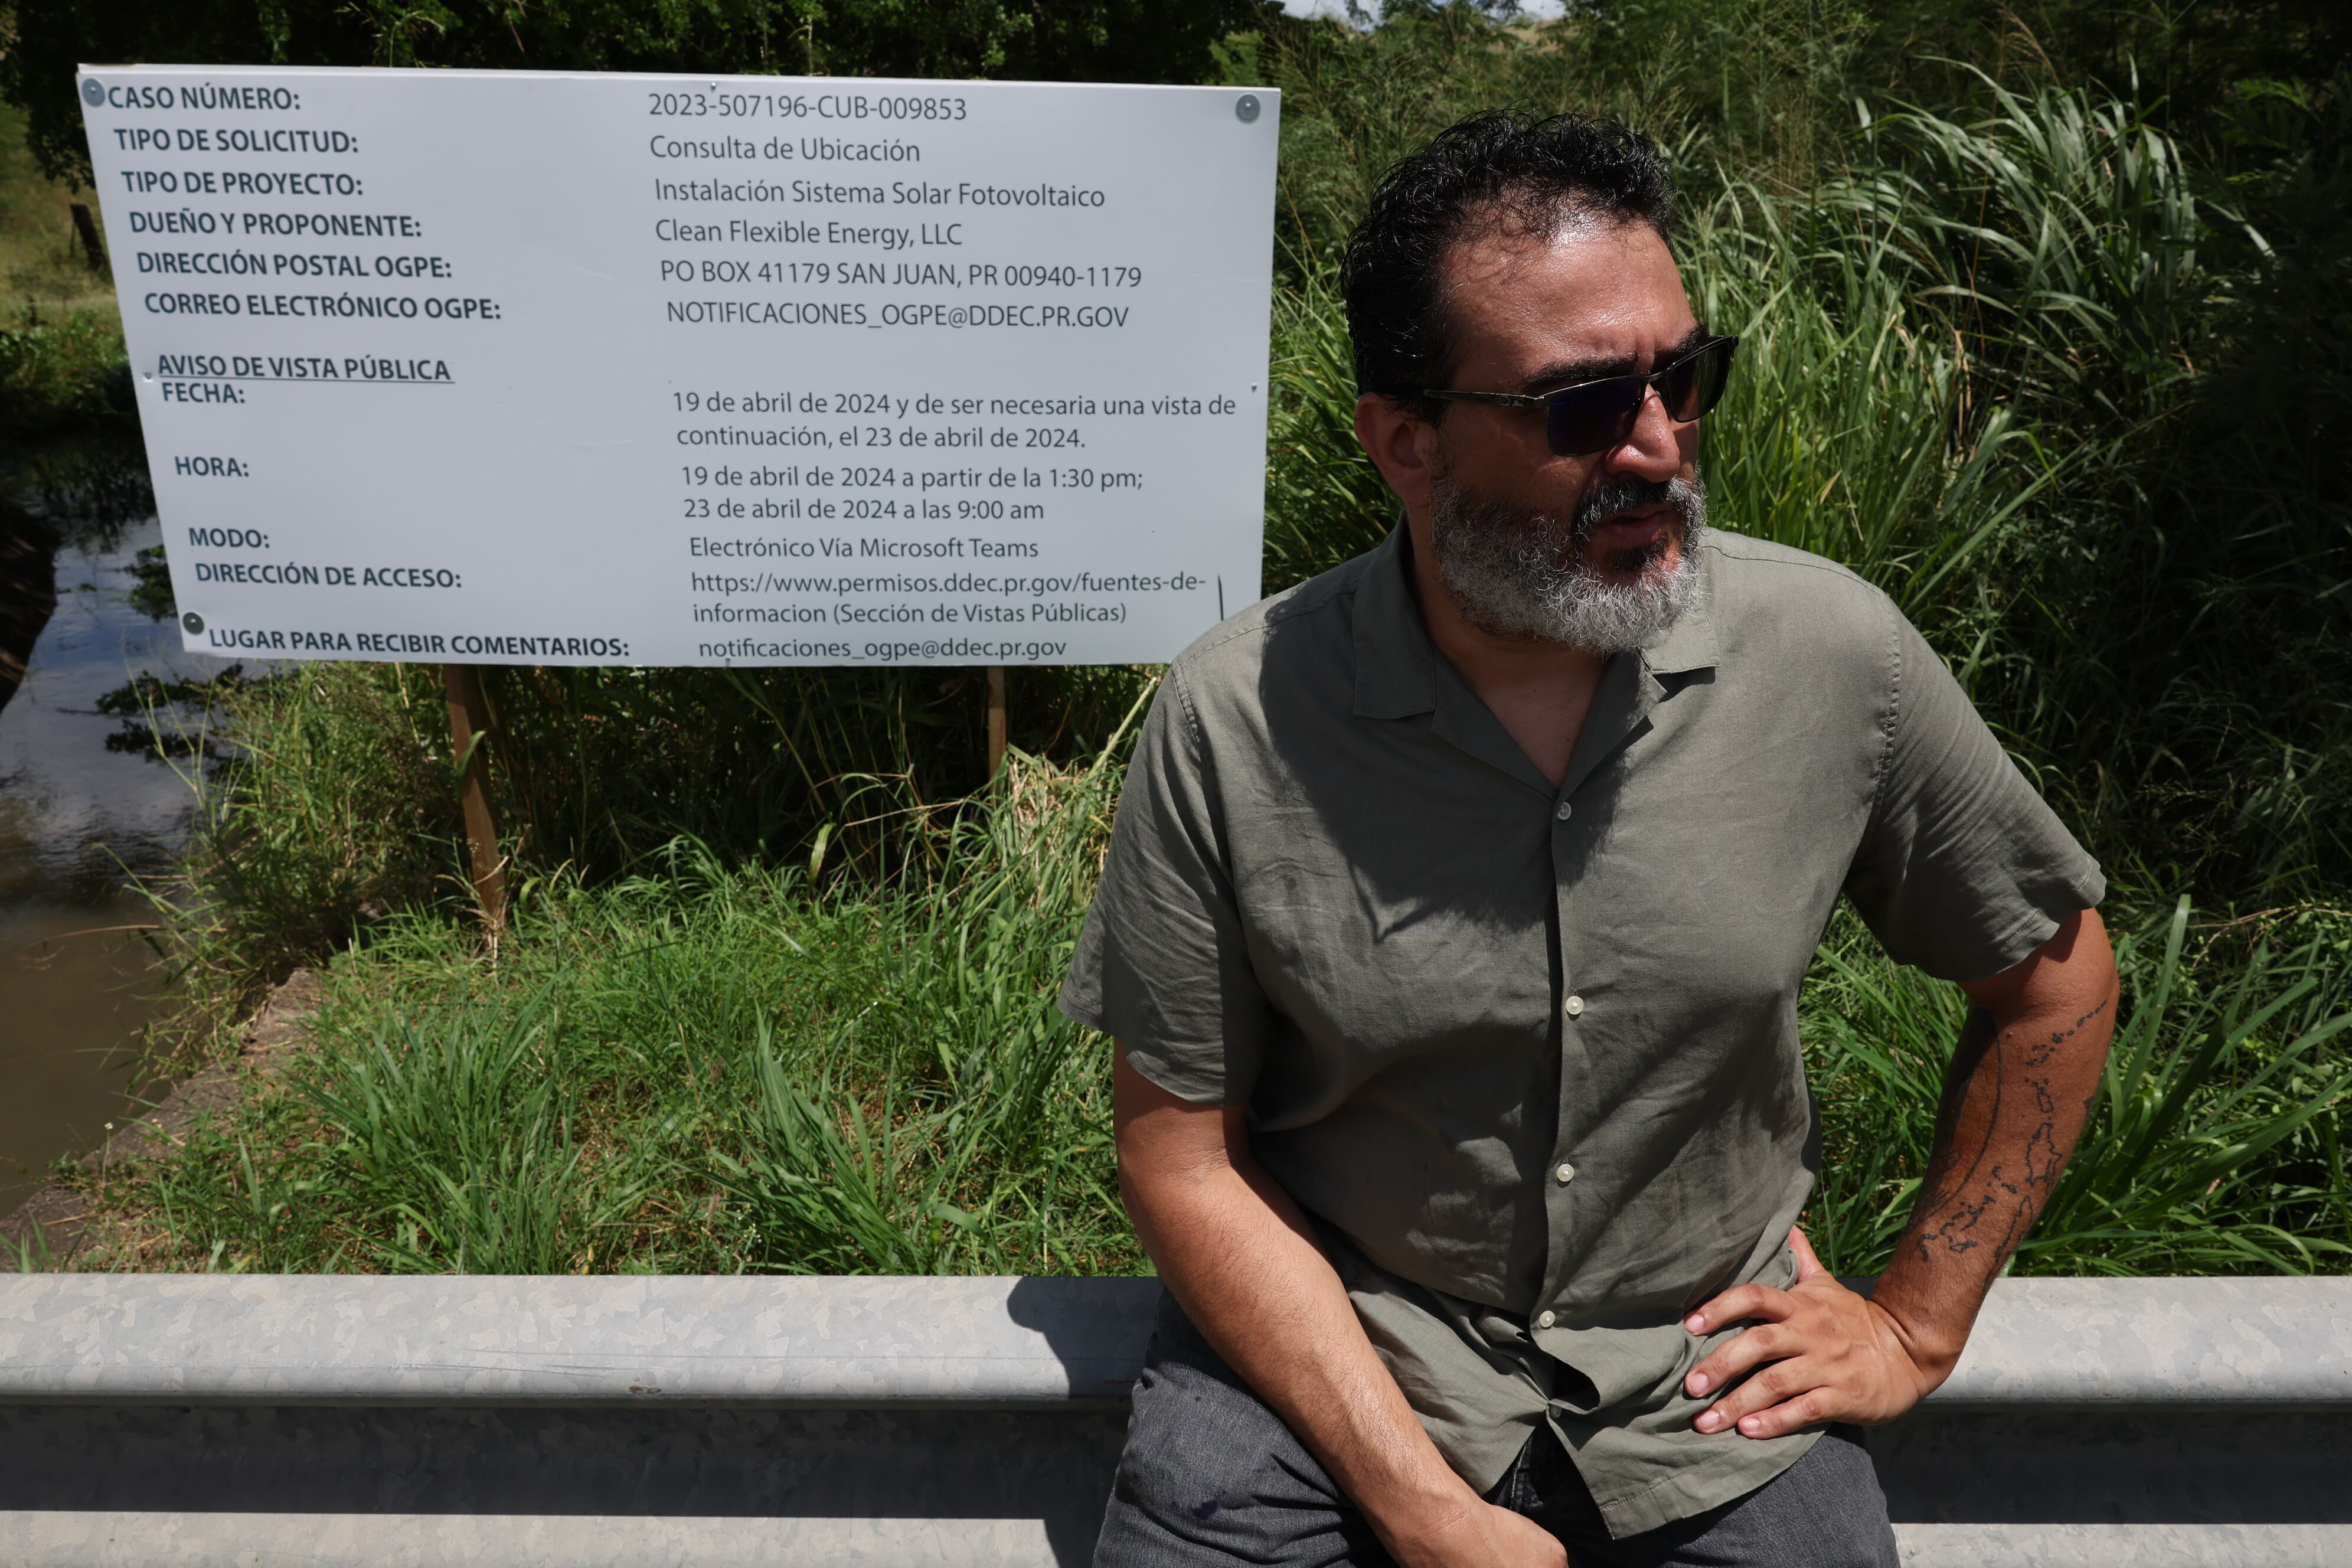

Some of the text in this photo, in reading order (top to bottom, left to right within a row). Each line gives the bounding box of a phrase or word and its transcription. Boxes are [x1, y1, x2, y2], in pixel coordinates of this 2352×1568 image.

[107, 82, 300, 110] CASO NÚMERO:
[649, 93, 966, 120] 2023-507196-CUB-009853
[113, 129, 358, 153] TIPO DE SOLICITUD:
[651, 135, 920, 162] Consulta de Ubicación
[120, 171, 363, 195] TIPO DE PROYECTO:
[656, 178, 1105, 207] Instalación Sistema Solar Fotovoltaico
[129, 207, 422, 237] DUEÑO Y PROPONENTE:
[656, 218, 962, 250] Clean Flexible Energy, LLC
[136, 249, 452, 278] DIRECCIÓN POSTAL OGPE:
[661, 260, 1141, 288] PO BOX 41179 SAN JUAN, PR 00940-1179
[145, 292, 501, 319] CORREO ELECTRÓNICO OGPE:
[668, 301, 1129, 328] NOTIFICACIONES_OGPE@DDEC.PR.GOV
[158, 354, 451, 380] AVISO DE VISTA PÚBLICA
[162, 382, 245, 404] FECHA:
[674, 391, 1236, 419] 19 de abril de 2024 y de ser necesaria una vista de
[677, 426, 1085, 449] continuación, el 23 de abril de 2024.
[175, 456, 249, 477] HORA:
[682, 465, 1142, 492] 19 de abril de 2024 a partir de la 1:30 pm;
[684, 498, 1043, 519] 23 de abril de 2024 a las 9:00 am
[189, 527, 270, 548] MODO:
[690, 537, 1038, 557] Electrónico Vía Microsoft Teams
[195, 561, 462, 588] DIRECCIÓN DE ACCESO:
[692, 571, 1206, 597] https://www.permisos.ddec.pr.gov/fuentes-de-
[694, 603, 1126, 625] informacion (Sección de Vistas Públicas)
[209, 629, 629, 656] LUGAR PARA RECIBIR COMENTARIOS:
[700, 638, 1066, 661] notificaciones_ogpe@ddec.pr.gov
